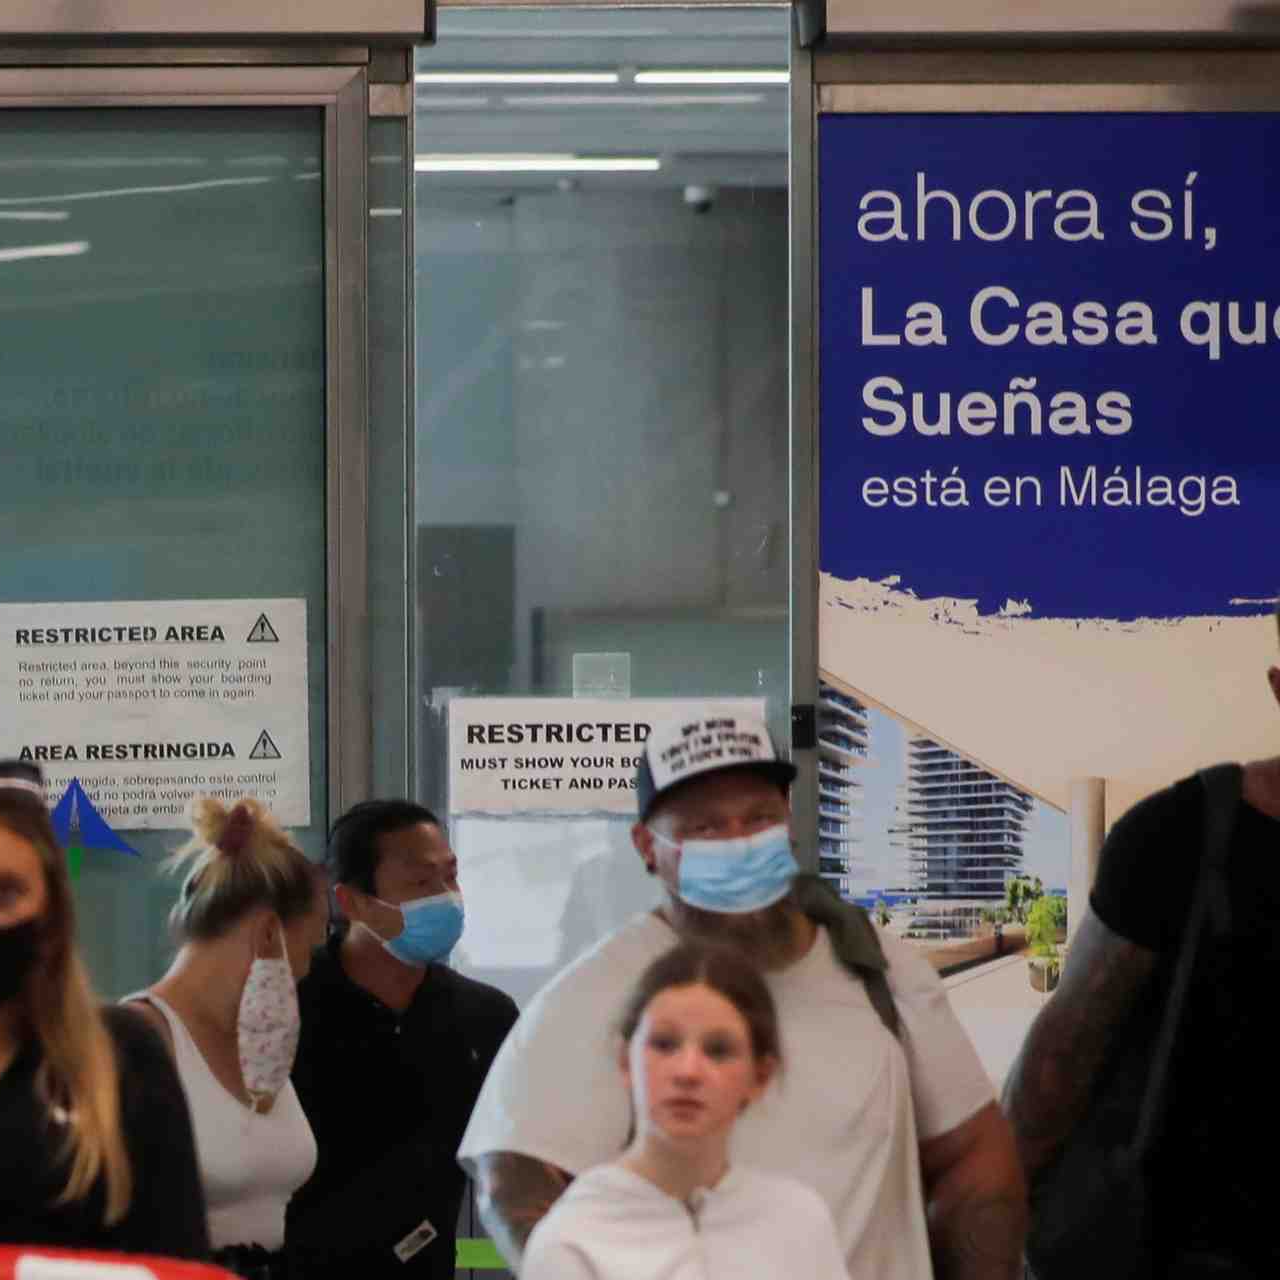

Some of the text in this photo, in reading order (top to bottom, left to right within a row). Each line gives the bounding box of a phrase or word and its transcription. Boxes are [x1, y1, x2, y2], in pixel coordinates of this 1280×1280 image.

[856, 171, 1218, 252] ahora sí,
[860, 285, 1280, 361] La Casa qu
[861, 375, 1133, 437] Sueñas
[860, 465, 1241, 517] está en Málaga
[15, 624, 226, 645] RESTRICTED AREA
[17, 660, 77, 673] Restricted
[238, 657, 267, 671] point
[466, 723, 652, 745] RESTRICTED
[19, 742, 237, 762] AREA RESTRINGIDA
[460, 757, 508, 771] MUST
[513, 756, 565, 770] SHOW
[570, 756, 615, 769] YOUR
[500, 777, 563, 791] TICKET
[568, 777, 604, 790] AND
